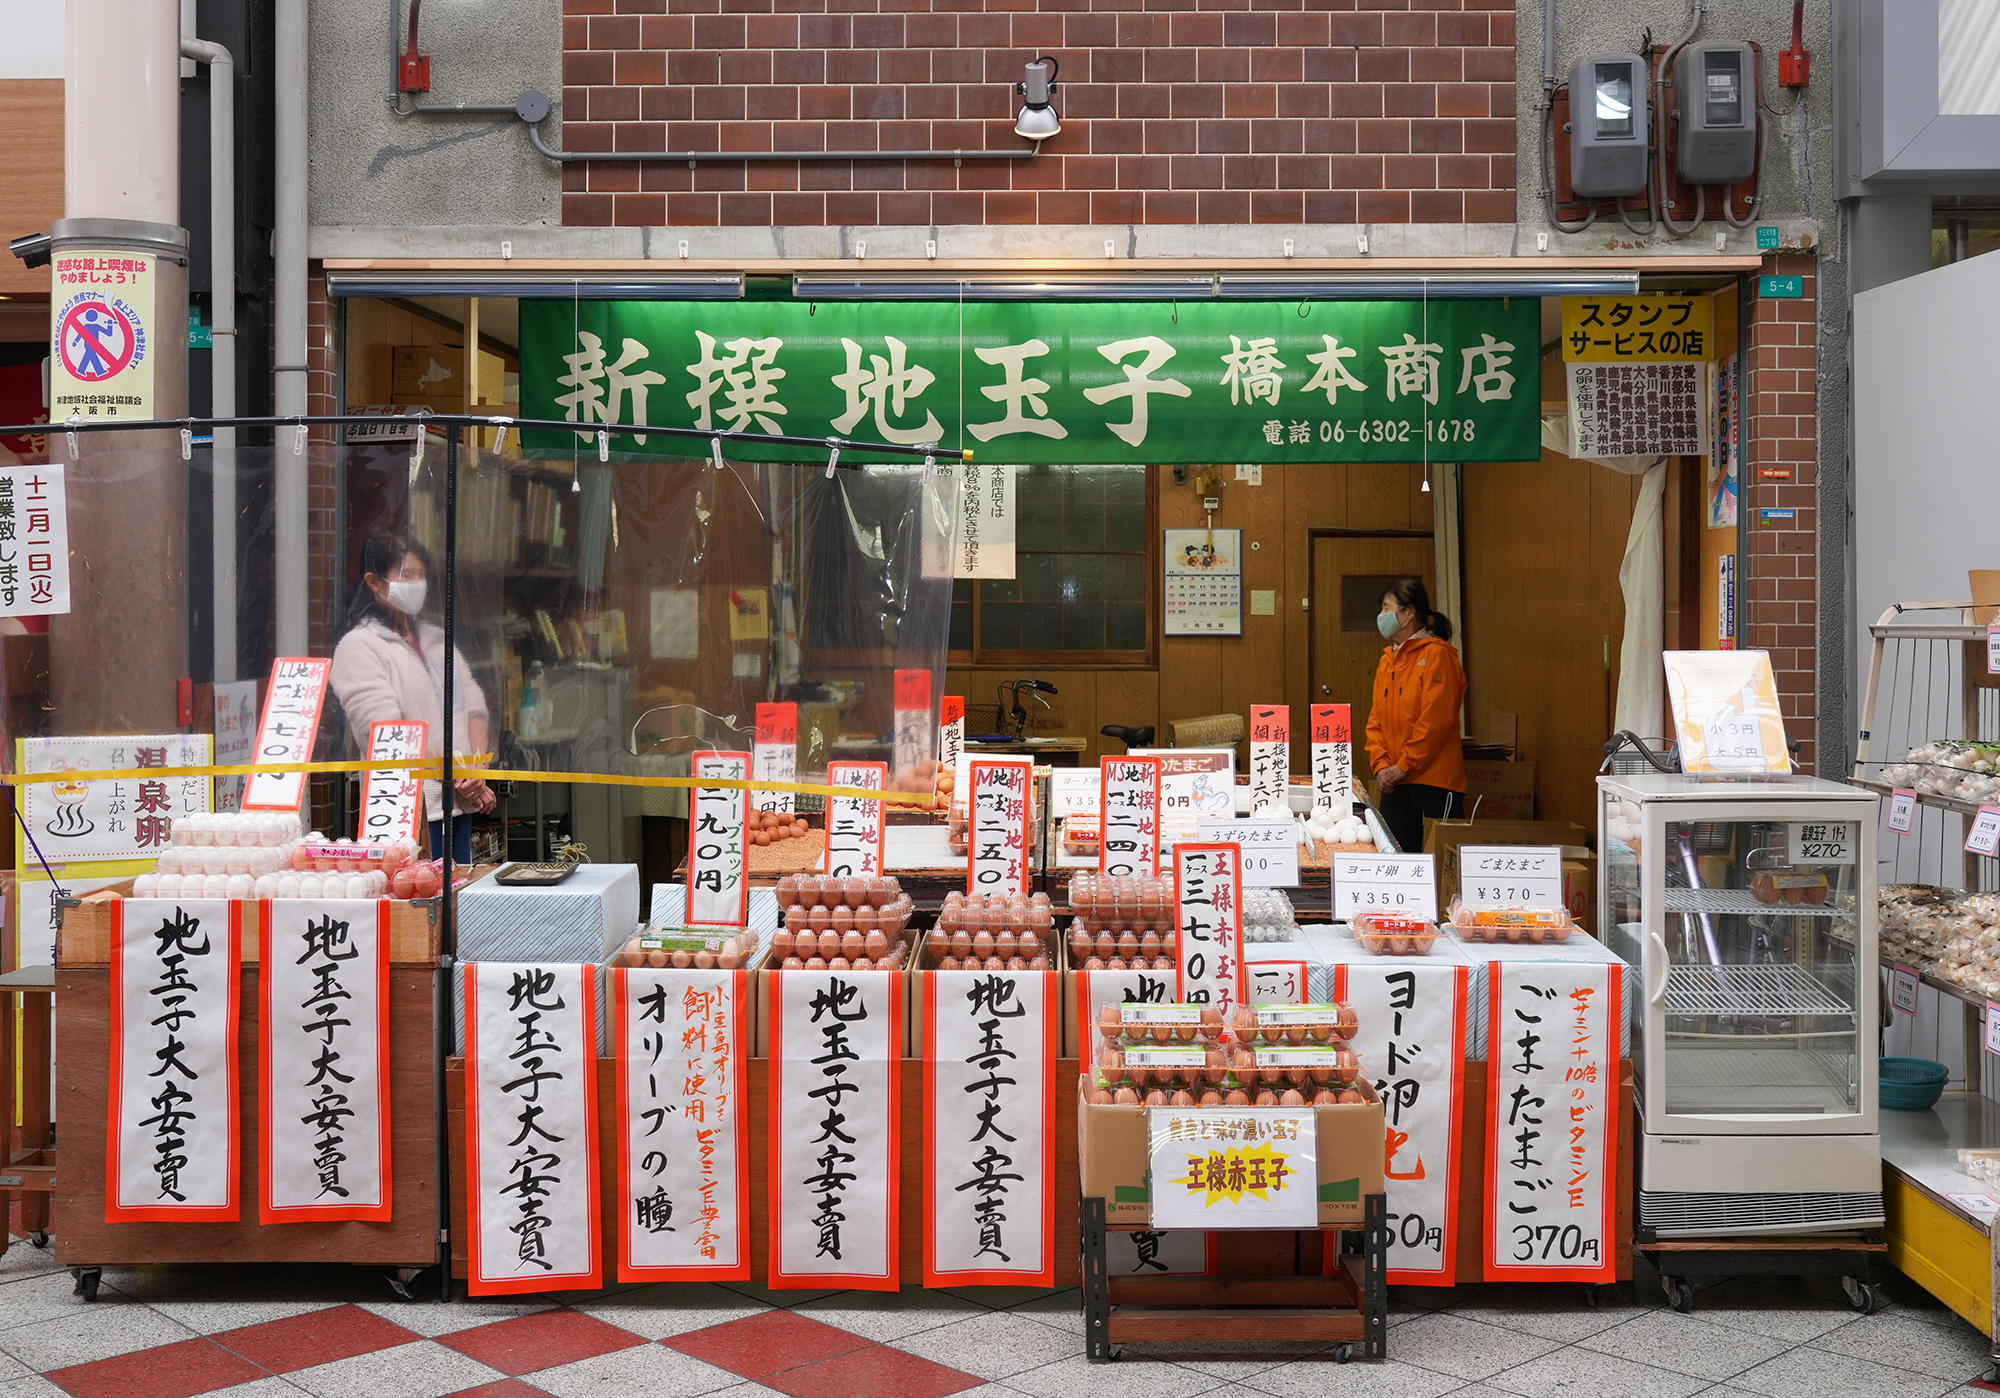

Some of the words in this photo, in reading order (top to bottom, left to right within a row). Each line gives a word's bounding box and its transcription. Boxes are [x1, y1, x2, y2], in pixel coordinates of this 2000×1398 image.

[56, 258, 147, 272] 迷惑な路上喫煙は
[1770, 280, 1794, 292] 5-4
[1569, 330, 1704, 356] サービスの店
[1580, 300, 1694, 328] スタンプ
[554, 330, 1192, 447] 新撰地玉子
[1219, 332, 1517, 406] 橋本商店
[72, 406, 117, 416] 大阪市
[1262, 418, 1311, 445] 電話
[1319, 418, 1476, 444] 06-6302-1678
[1595, 366, 1609, 456] 鹿児島県南九州市
[1608, 366, 1622, 454] 鹿児島県霧島市
[1620, 366, 1634, 454] 宮崎県児湯郡
[1633, 366, 1646, 454] 大分県速見郡
[1672, 364, 1686, 454] 京都府舞鶴市
[1684, 364, 1698, 454] 愛知県豊橋市
[990, 464, 1004, 518] 本商店では
[25, 475, 53, 604] 十二月一日(火)
[292, 664, 324, 761] 新撰地玉子
[1254, 710, 1275, 741] 一個
[1316, 709, 1336, 742] 一個
[1710, 724, 1722, 734] 小
[108, 748, 126, 832] 召上がれ
[134, 747, 172, 848] 温泉卵
[180, 746, 197, 818] 特だし
[777, 726, 794, 813] 新撰地子
[976, 768, 994, 786] M
[1106, 764, 1126, 782] MS
[1271, 724, 1288, 798] 新撰地玉子
[1332, 724, 1350, 798] 新撰地玉子
[724, 760, 744, 890] オリーブエッグ
[975, 820, 1006, 896] 二五〇
[1213, 829, 1288, 842] うずらたまご
[1801, 826, 1826, 841] 温泉玉子
[1347, 864, 1400, 877] ヨード卵
[1410, 864, 1425, 878] 光
[1480, 858, 1546, 871] ごまたまご
[1210, 852, 1236, 1016] 王様赤玉子
[680, 985, 710, 1124] 飼料に使用
[636, 983, 676, 1234] オリーブの瞳
[1168, 1118, 1302, 1142] 黄身と味が濃い玉子
[1507, 984, 1559, 1215] ごまたまご
[1187, 1155, 1288, 1192] 王様赤玉子
[1512, 1224, 1599, 1262] 370円
